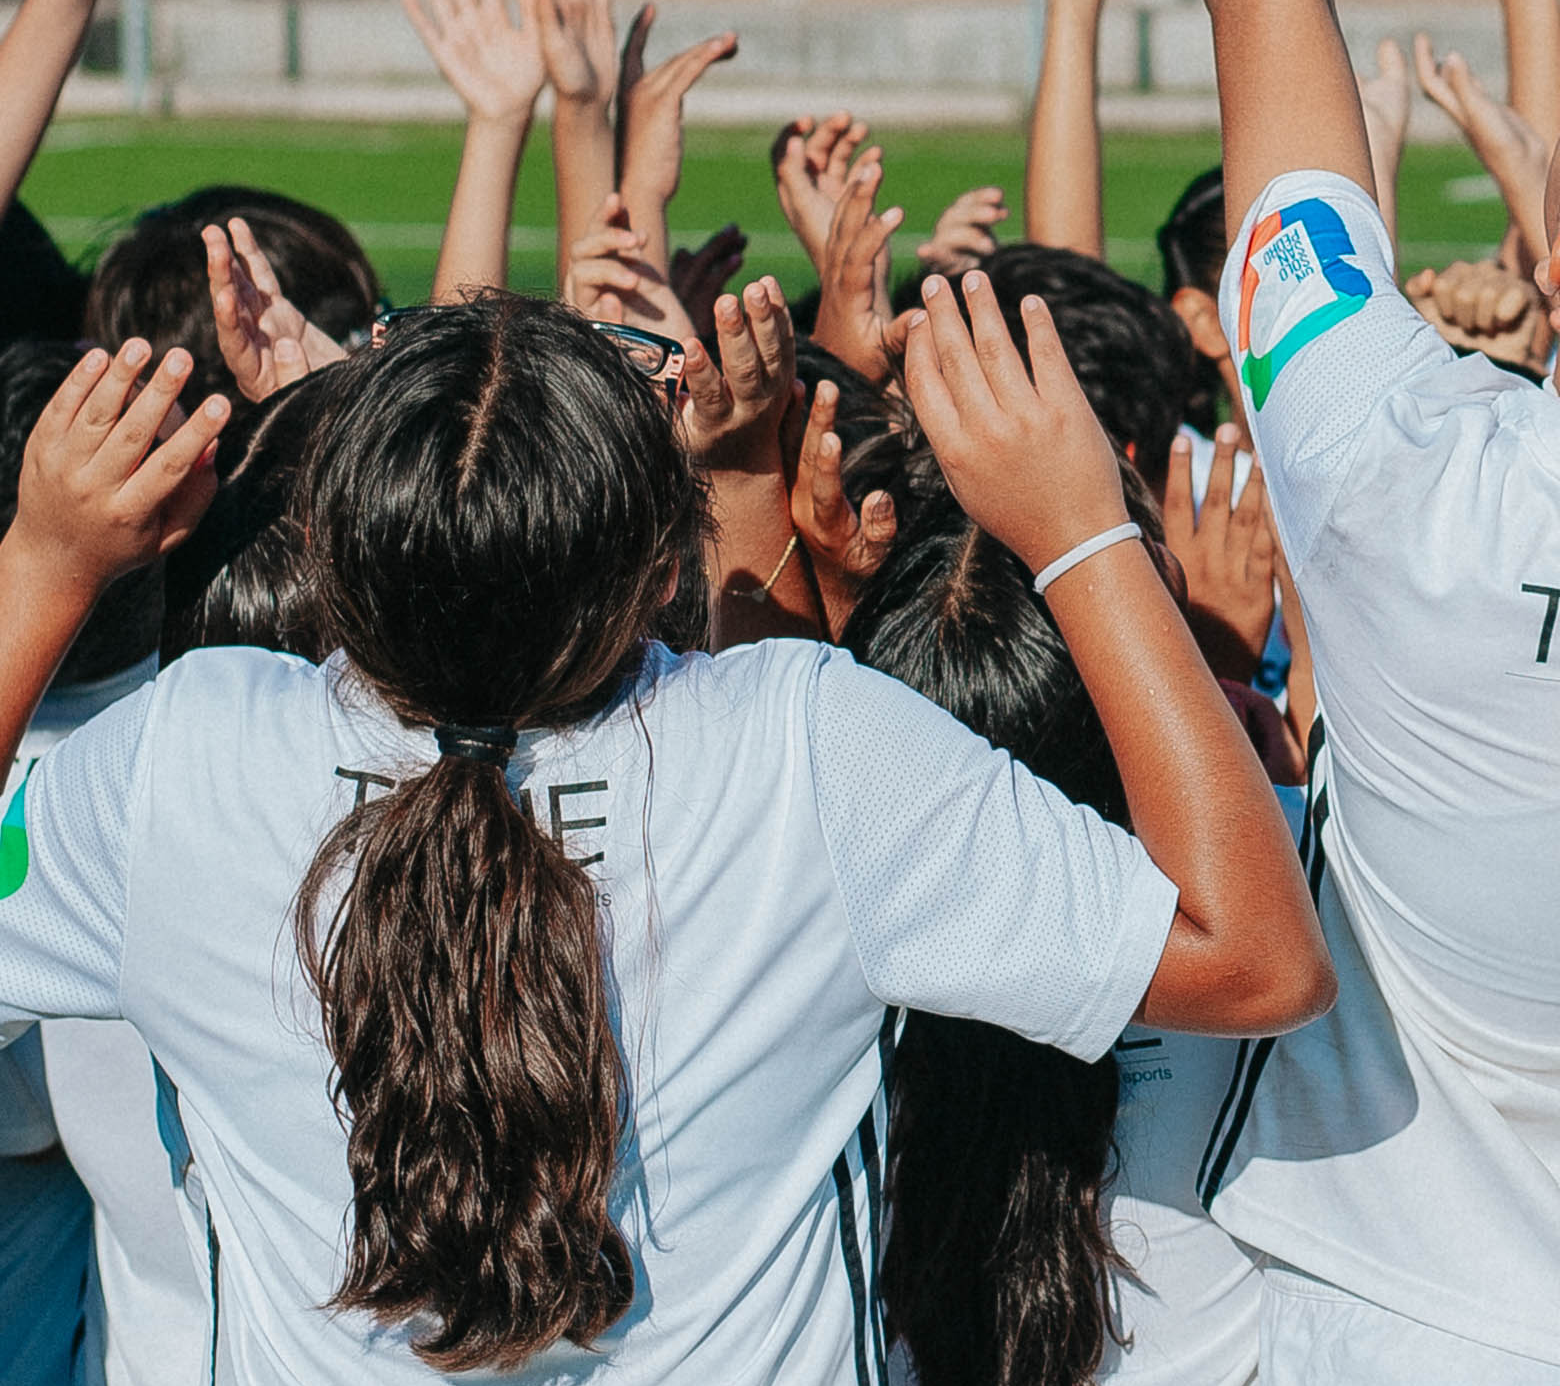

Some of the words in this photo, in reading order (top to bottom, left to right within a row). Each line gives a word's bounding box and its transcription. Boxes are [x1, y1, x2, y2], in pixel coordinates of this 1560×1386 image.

[1262, 228, 1300, 266] PEDRO
[1276, 239, 1305, 267] SAN
[1278, 255, 1311, 282] SOLO
[1294, 266, 1315, 284] UN
